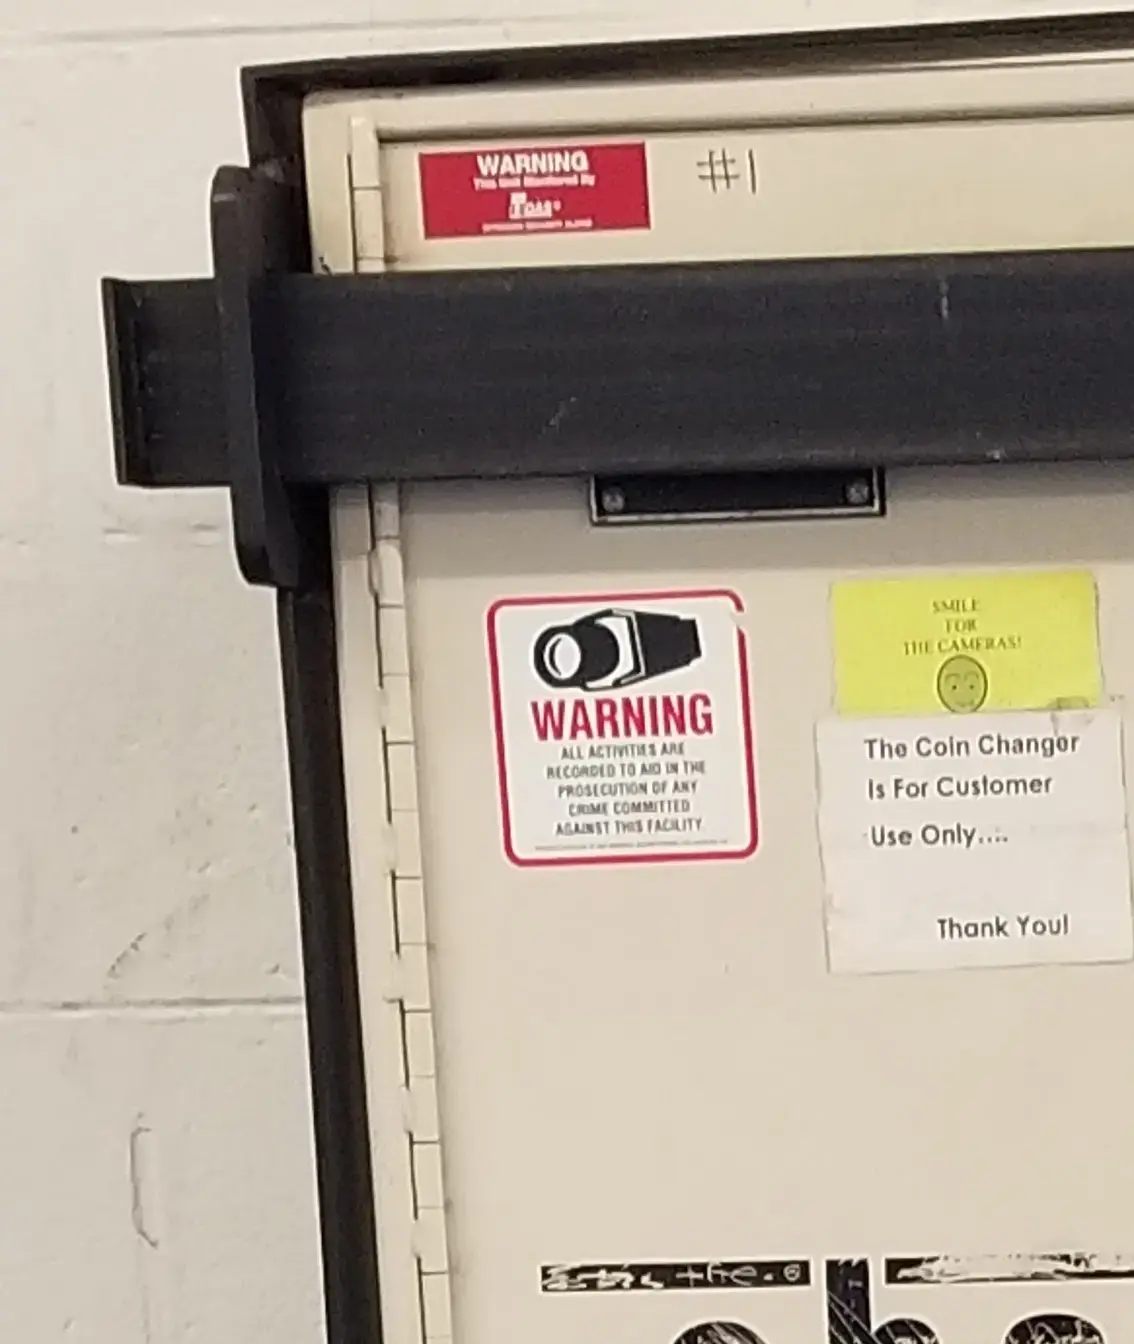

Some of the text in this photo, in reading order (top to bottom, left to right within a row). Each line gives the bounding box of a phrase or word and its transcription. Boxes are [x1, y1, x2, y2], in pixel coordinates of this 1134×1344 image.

[477, 150, 589, 176] WARNING
[697, 147, 757, 195] #1
[932, 598, 980, 614] SMILE
[945, 619, 977, 633] FOR
[904, 640, 932, 655] THE
[530, 693, 714, 742] WARNING
[561, 742, 685, 760] ALL ACTIVITIES ARE
[864, 730, 1080, 760] The Coin Changer
[546, 760, 706, 780] RECORDED TO AID IN THE
[558, 779, 698, 799] PROSECUTION OF ANY
[868, 773, 1053, 800] Is For Customer
[568, 799, 691, 817] CRIME COMMITTED
[555, 818, 702, 836] AGAINST THIS FACILITY
[871, 825, 912, 847] Use
[937, 913, 1070, 939] Thank You!
